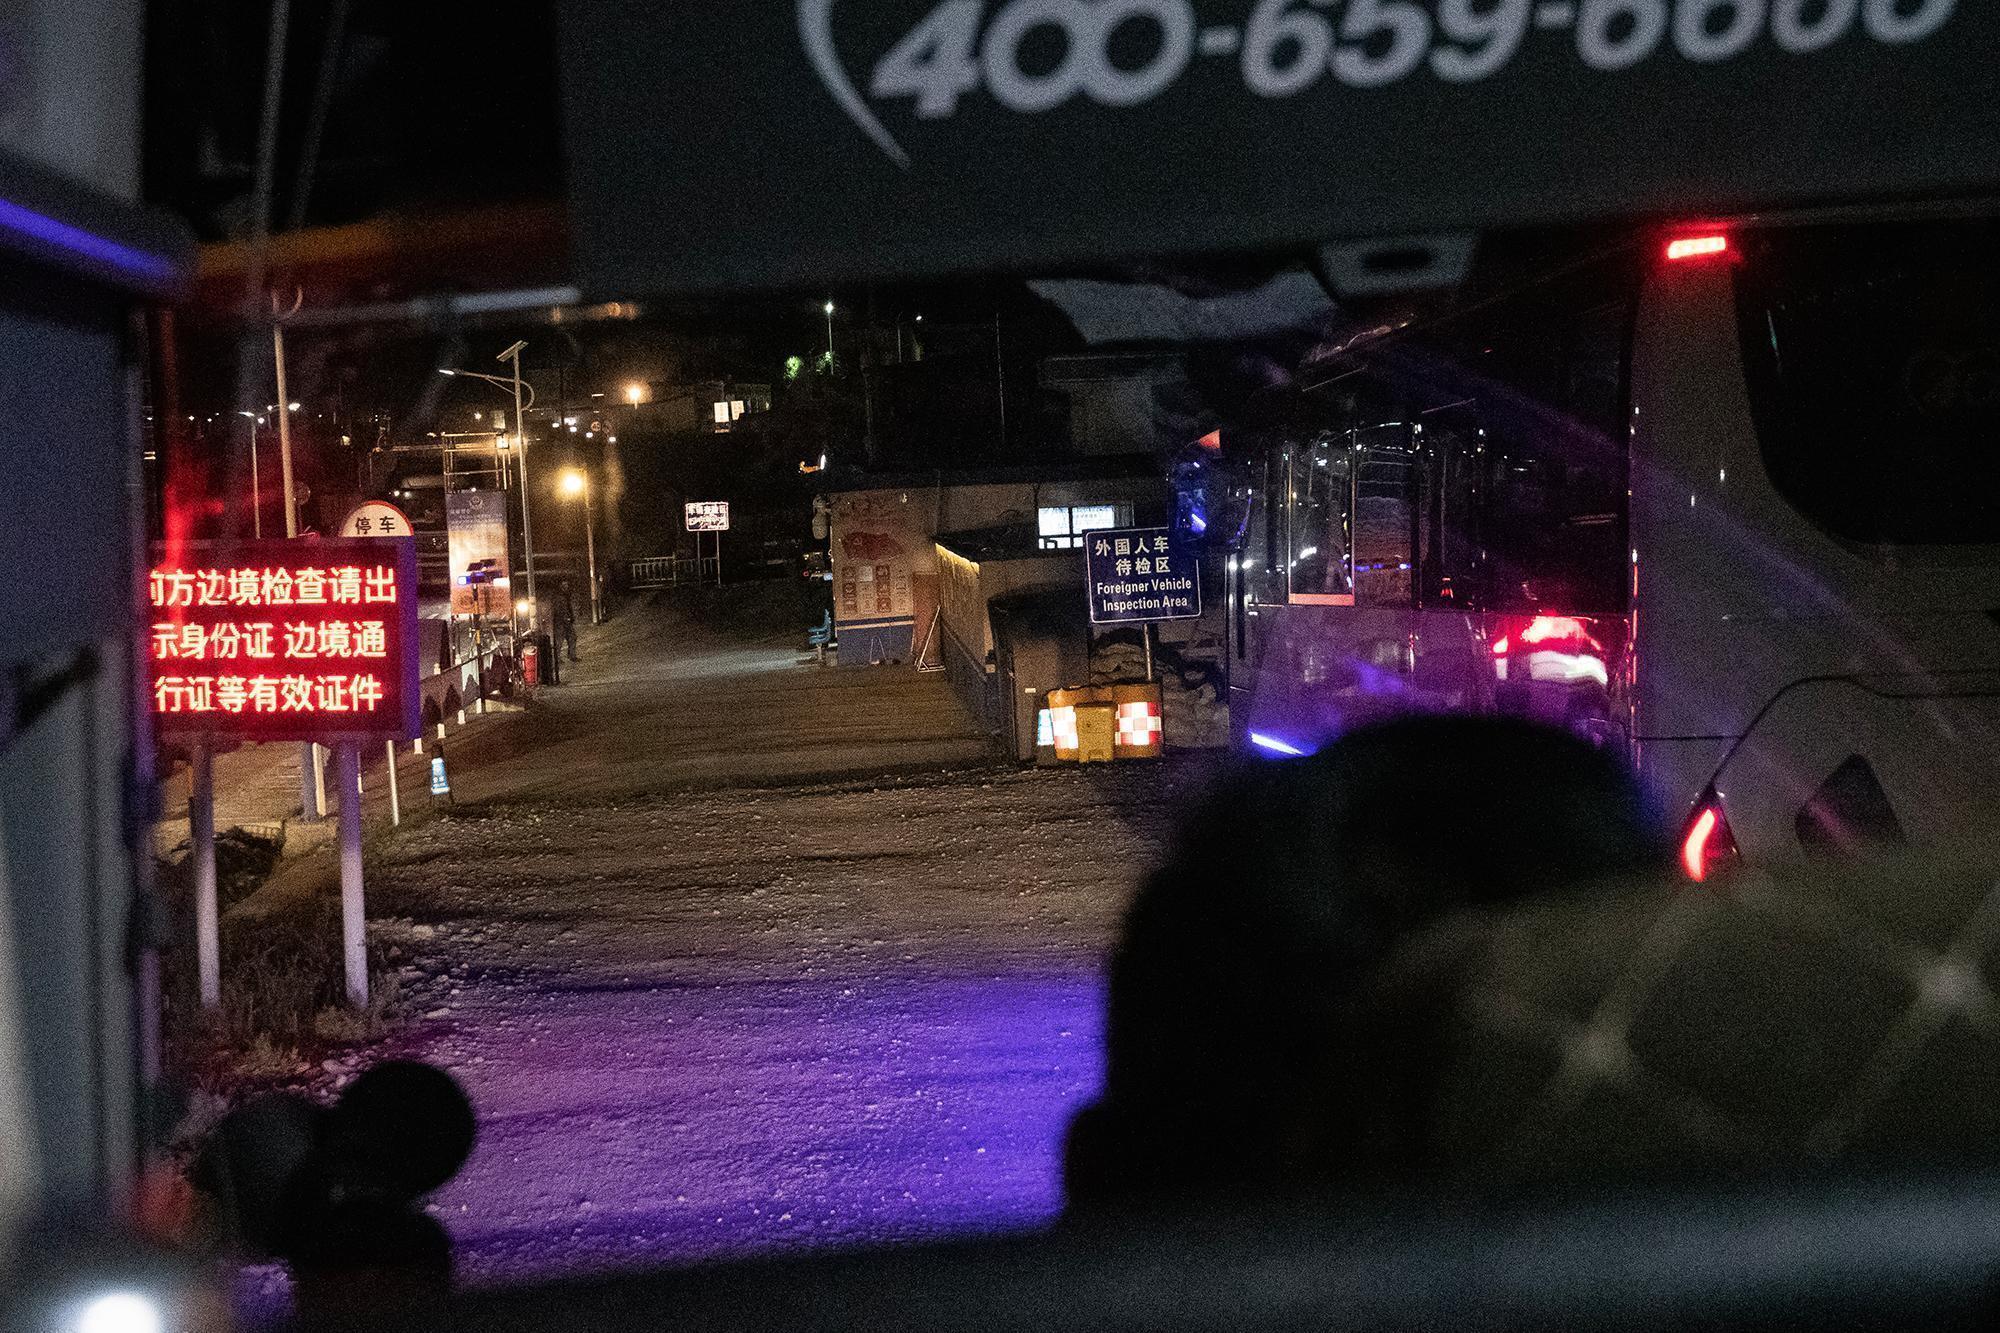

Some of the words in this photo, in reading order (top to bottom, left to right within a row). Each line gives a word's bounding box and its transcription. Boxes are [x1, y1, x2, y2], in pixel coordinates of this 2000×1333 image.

[355, 516, 395, 535] 停车
[1095, 536, 1170, 556] 外国人车
[1115, 556, 1171, 577] 待检区
[1097, 582, 1149, 596] Foreigner
[1151, 577, 1192, 592] Vehicle
[1103, 598, 1160, 613] Inspection
[1162, 595, 1188, 608] Area
[152, 621, 275, 659] 示身份证
[284, 620, 387, 659] 边境通
[155, 674, 384, 713] 行证等有效证件
